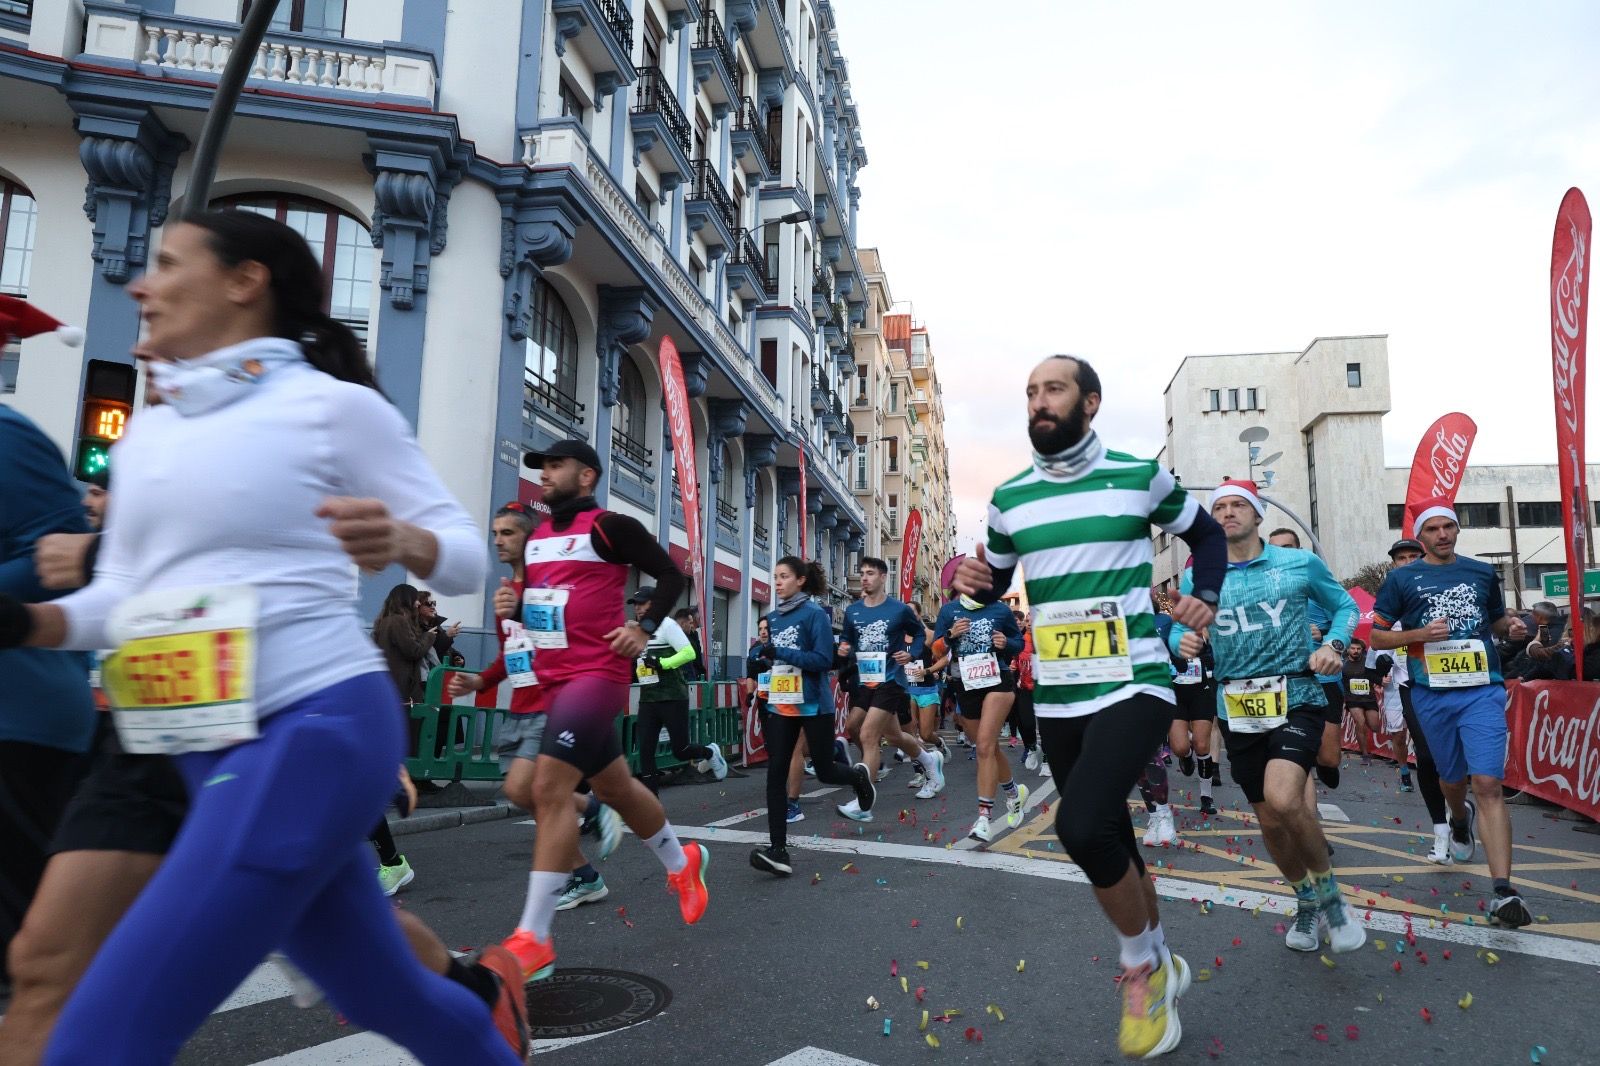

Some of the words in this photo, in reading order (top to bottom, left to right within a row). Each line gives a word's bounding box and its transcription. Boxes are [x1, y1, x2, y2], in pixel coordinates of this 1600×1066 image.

[98, 409, 126, 440] 10
[1430, 424, 1468, 499] a-Cola
[1214, 599, 1288, 637] SLY
[1055, 630, 1096, 658] 277
[967, 664, 991, 680] 2223
[1440, 656, 1471, 673] 344
[777, 679, 790, 692] 513
[1241, 698, 1267, 717] 168
[1526, 689, 1600, 806] Coca-C
